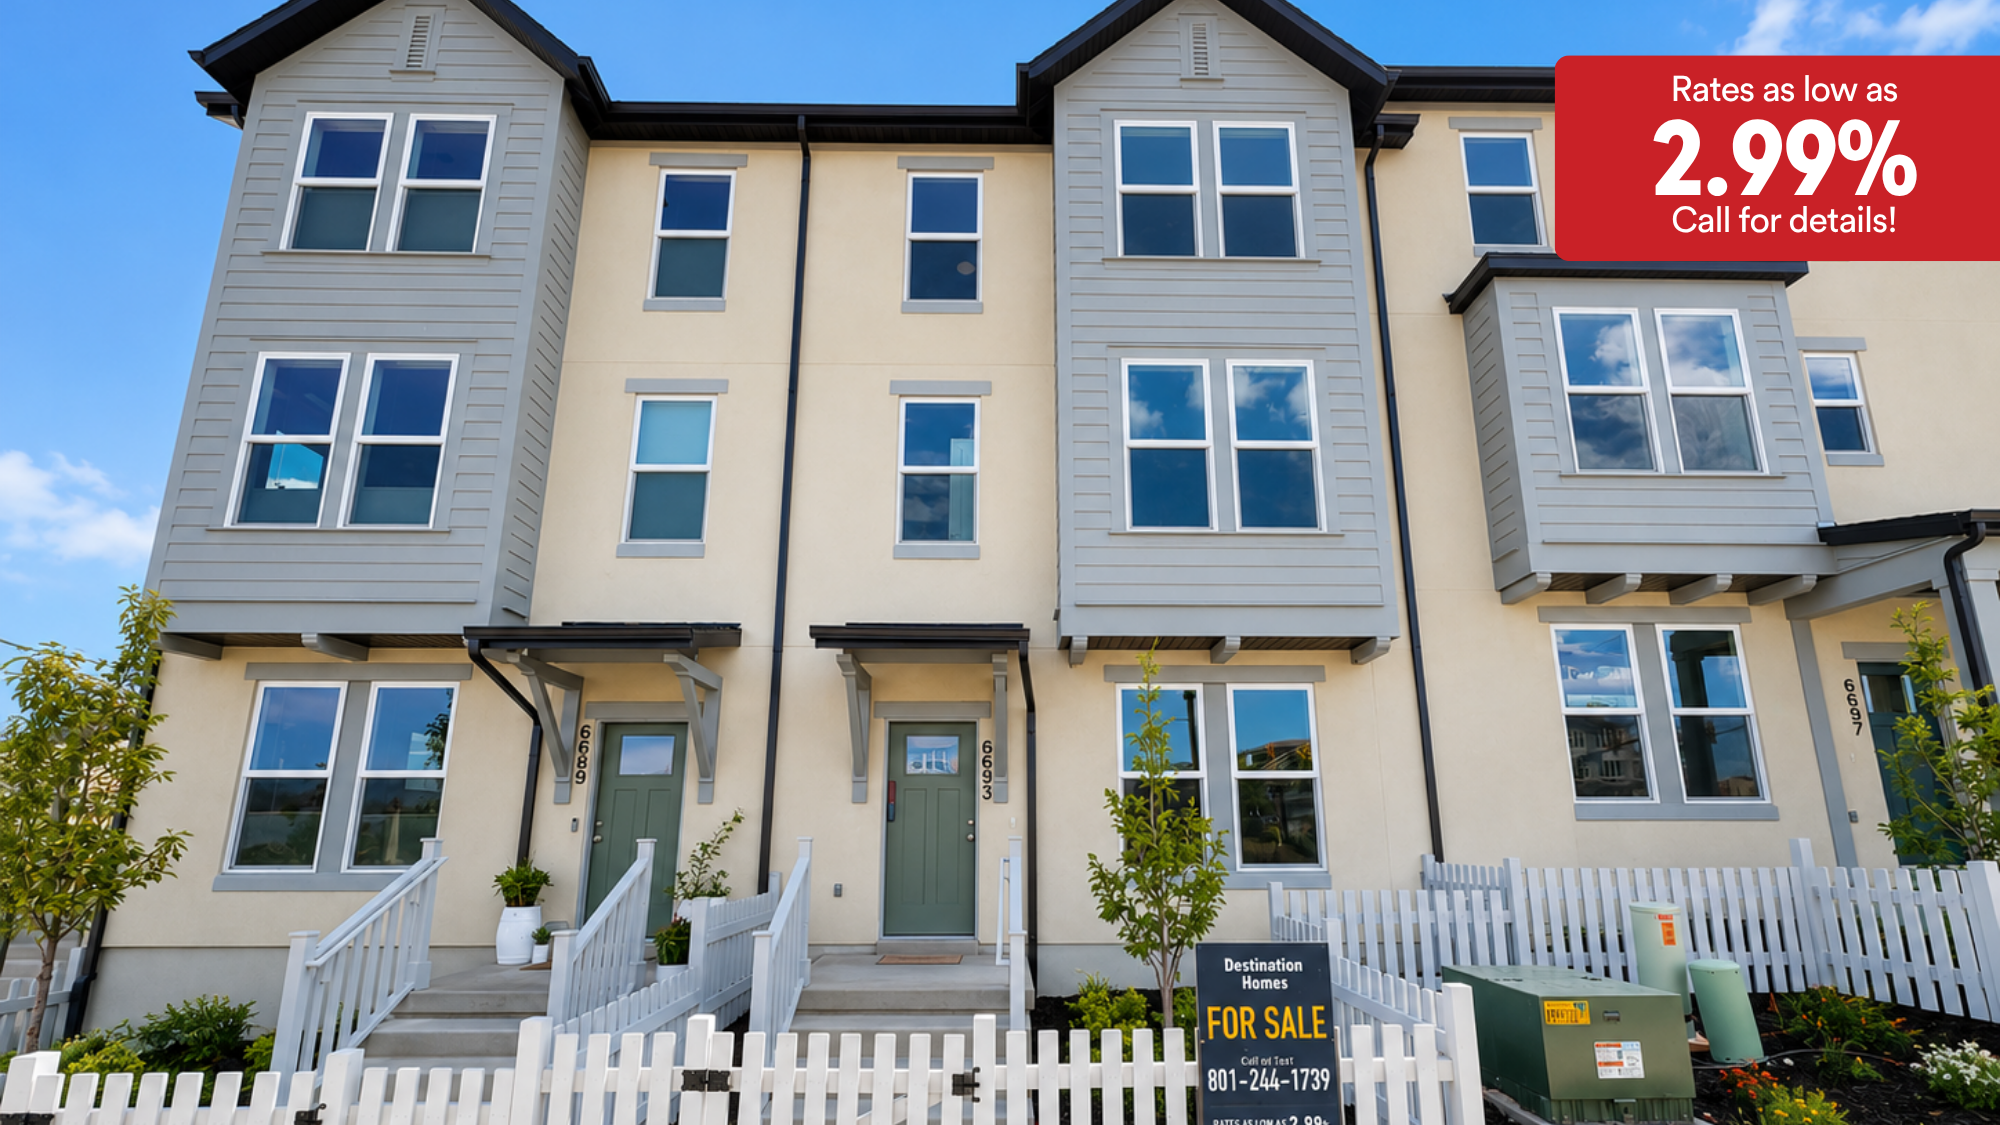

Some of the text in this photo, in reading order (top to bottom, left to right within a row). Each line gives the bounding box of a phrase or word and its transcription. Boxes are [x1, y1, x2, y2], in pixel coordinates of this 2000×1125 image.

[1843, 678, 1863, 736] 6697
[575, 724, 592, 785] 6689
[981, 740, 993, 800] 6693
[1224, 957, 1303, 973] Destination
[1242, 975, 1289, 990] Homes
[1207, 1005, 1328, 1040] FOR SALE
[1207, 1067, 1331, 1092] 801-244-1739
